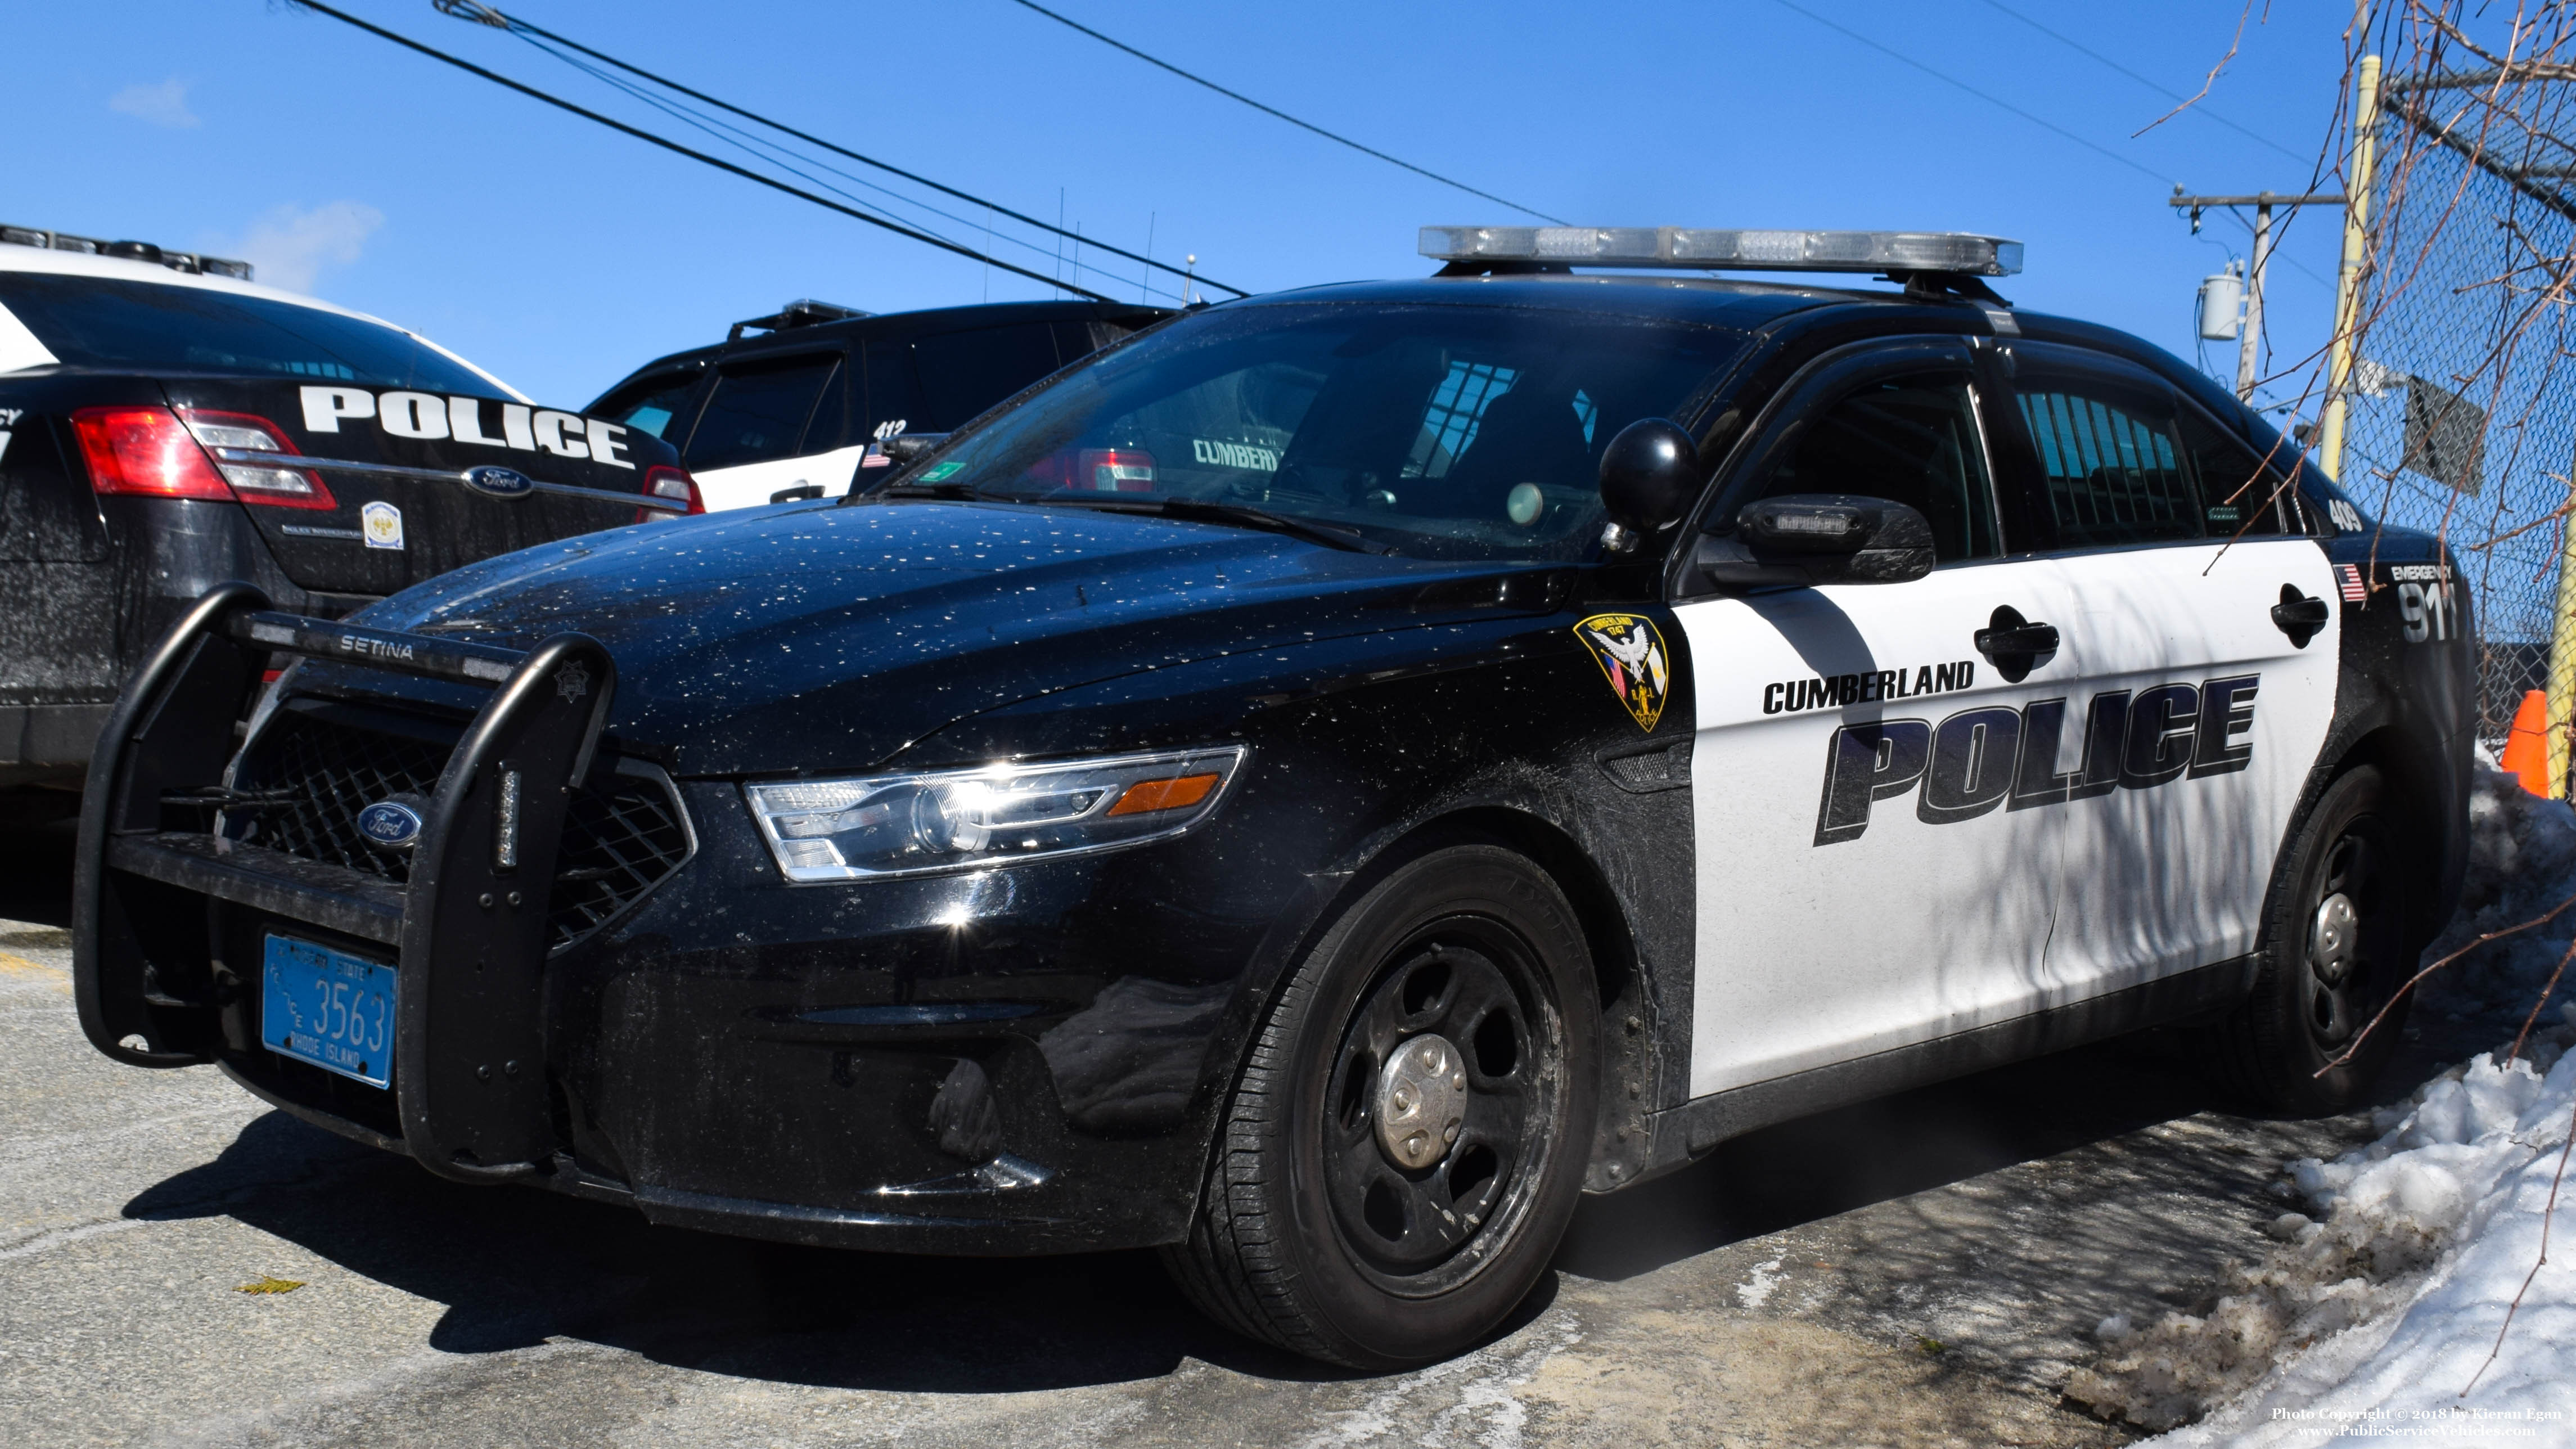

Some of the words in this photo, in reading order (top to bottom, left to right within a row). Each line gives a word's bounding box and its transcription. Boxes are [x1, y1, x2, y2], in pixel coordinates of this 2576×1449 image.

[300, 386, 636, 470] POLICE
[1193, 439, 1279, 472] CUMBERL
[483, 470, 520, 488] Ford
[2329, 500, 2362, 532] 409
[1587, 617, 1633, 631] CUMBERLAND
[2398, 583, 2457, 643] 911
[1607, 626, 1625, 636] 1747
[341, 635, 413, 660] SETINA
[1763, 660, 1975, 714] CUMBERLAND
[1635, 708, 1658, 725] POLICE
[1813, 673, 2261, 847] POLICE
[368, 809, 404, 836] Ford
[314, 978, 385, 1052] 3563
[290, 1030, 320, 1056] RHODE
[326, 1043, 361, 1068] ISLAND
